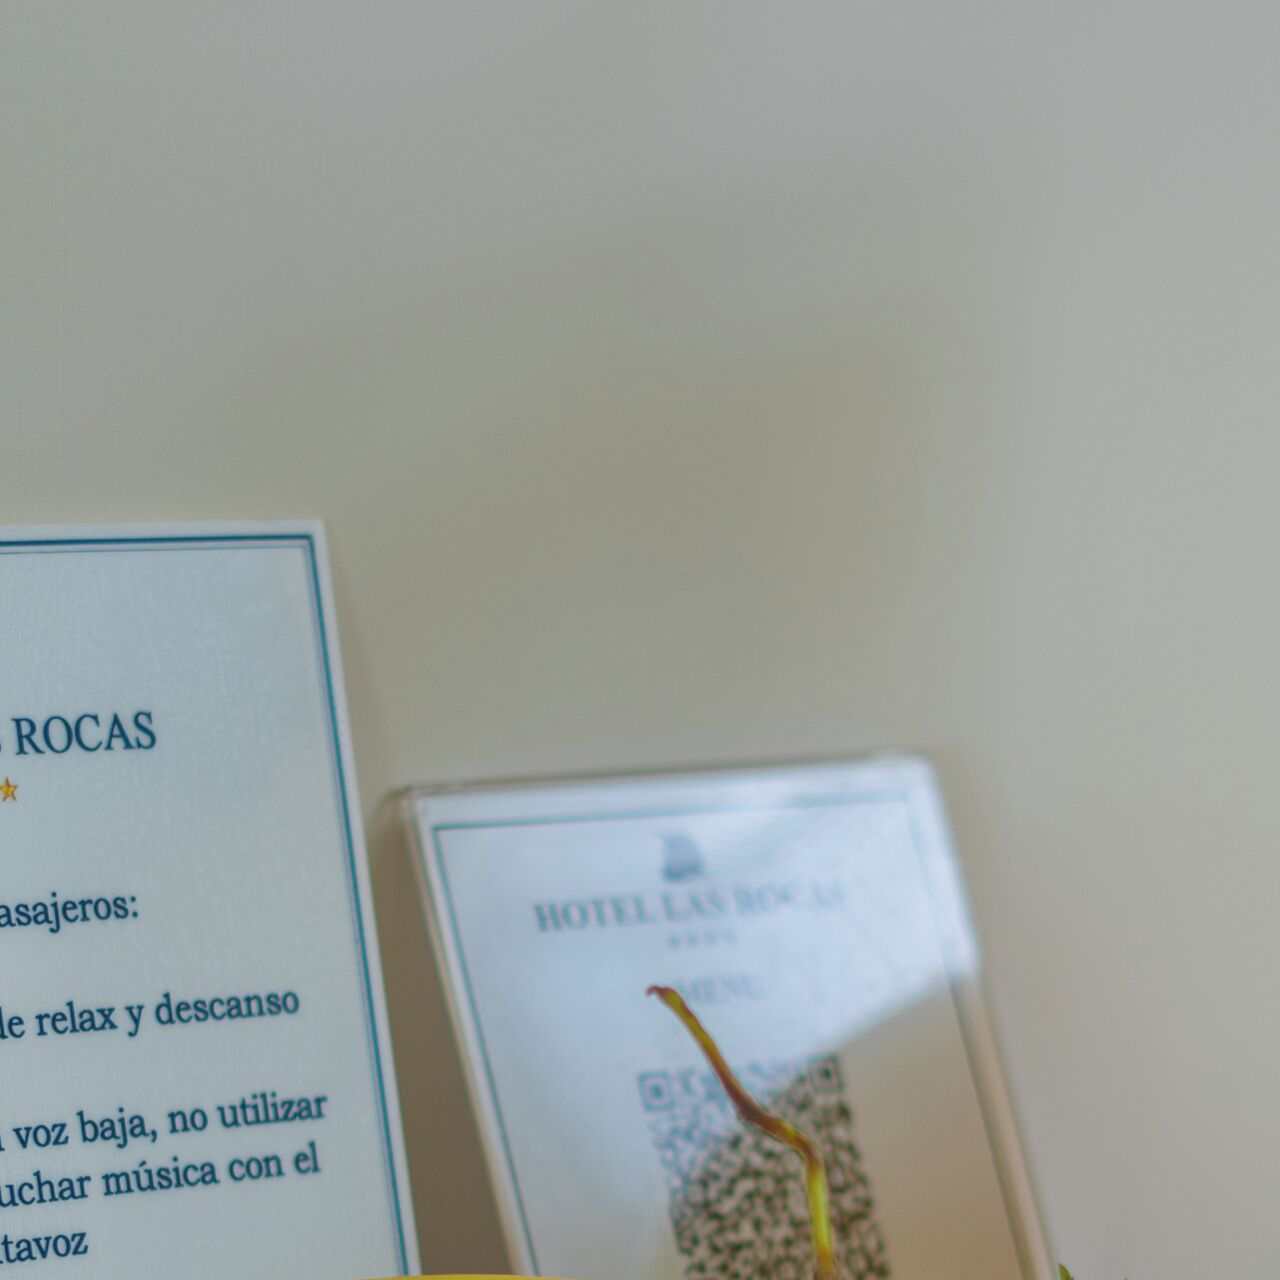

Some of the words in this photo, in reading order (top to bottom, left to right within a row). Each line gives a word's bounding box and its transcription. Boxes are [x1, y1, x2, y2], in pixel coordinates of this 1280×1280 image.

[12, 712, 156, 755] ROCAS
[533, 894, 656, 932] HOTEL
[661, 889, 727, 922] LAS
[35, 1001, 118, 1036] relax
[125, 1005, 144, 1037] y
[155, 992, 299, 1025] descanso
[13, 1123, 68, 1148] voz
[77, 1107, 157, 1148] baja,
[168, 1109, 208, 1133] no
[217, 1092, 327, 1128] utilizar
[102, 1156, 220, 1196] música
[229, 1155, 284, 1181] con
[294, 1141, 320, 1174] el
